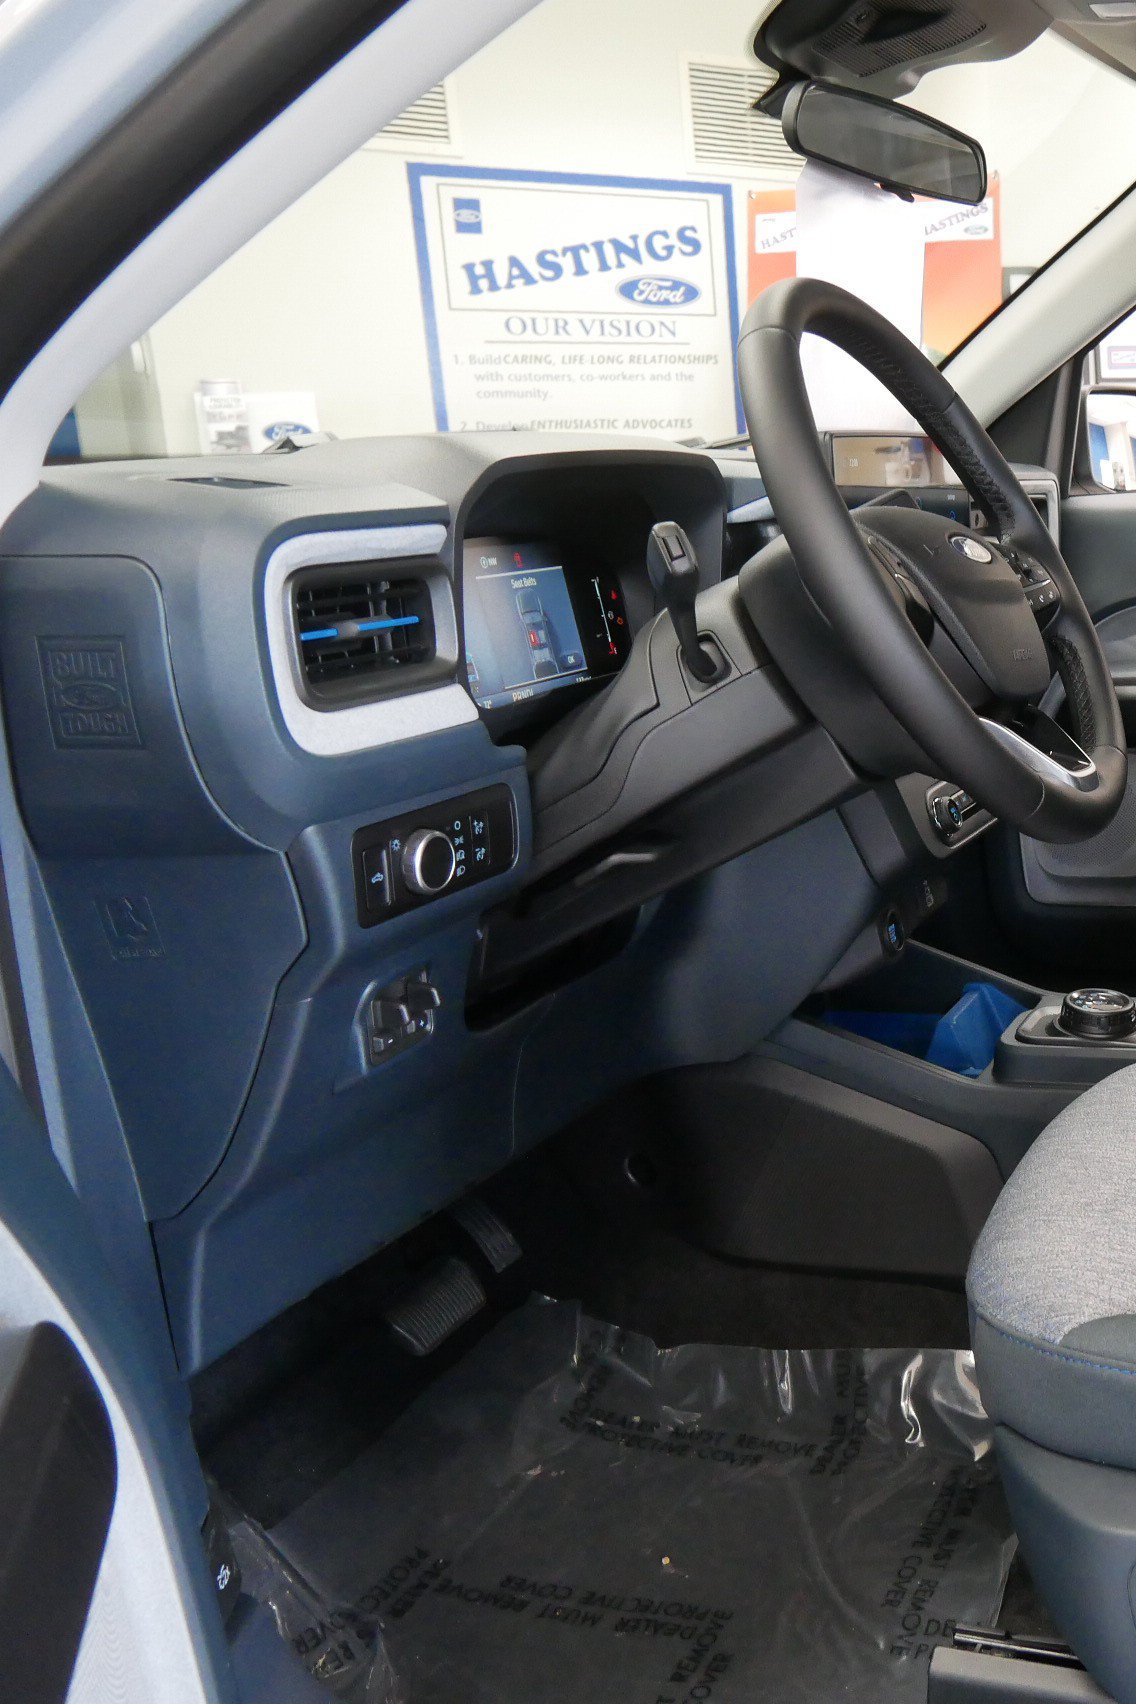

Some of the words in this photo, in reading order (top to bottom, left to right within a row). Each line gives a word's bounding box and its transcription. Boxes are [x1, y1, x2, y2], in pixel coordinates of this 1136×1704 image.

[760, 227, 797, 250] HAST
[462, 225, 703, 296] HASTINGS
[504, 315, 571, 337] OUR
[577, 318, 678, 338] VISION
[468, 353, 502, 366] Build
[503, 353, 557, 367] CARING,
[628, 354, 719, 366] RELATIONSHIPS
[474, 371, 504, 382] with
[507, 373, 576, 384] customers,
[579, 371, 646, 383] co-workers
[649, 372, 672, 382] and
[675, 372, 695, 382] the
[476, 388, 553, 401] community.
[530, 419, 618, 430] ENTHUSIASTIC
[623, 418, 693, 430] ADVOCATES
